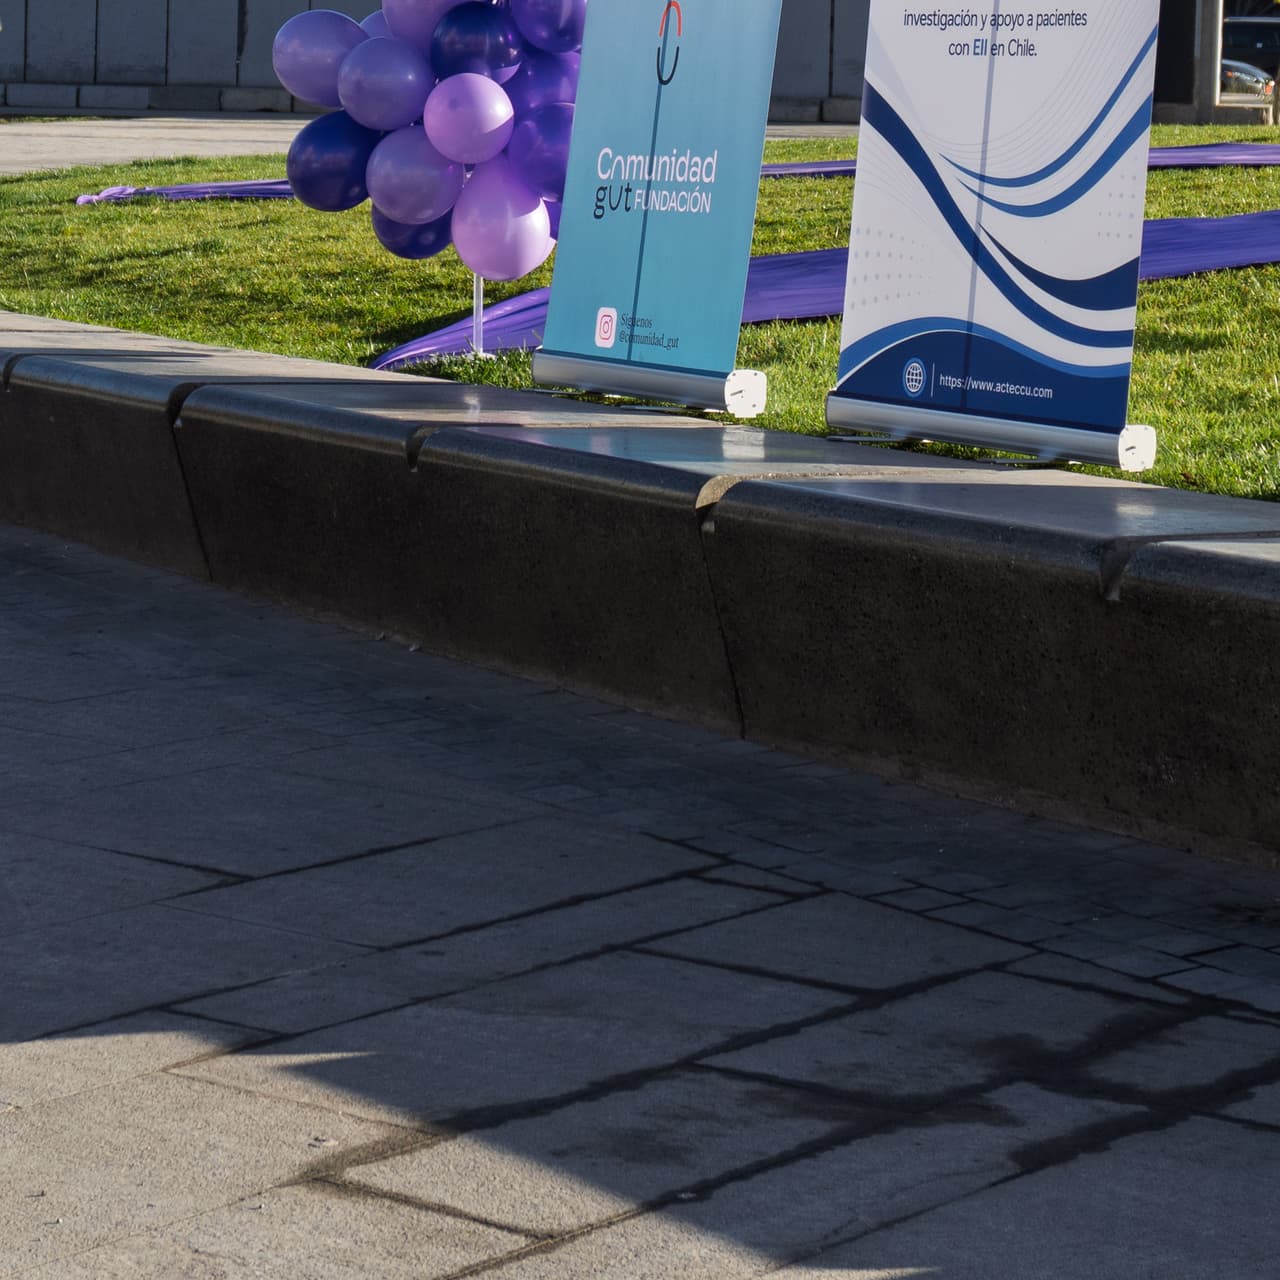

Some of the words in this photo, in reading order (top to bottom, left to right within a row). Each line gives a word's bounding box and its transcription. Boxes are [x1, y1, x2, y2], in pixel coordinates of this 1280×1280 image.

[903, 9, 978, 31] investigación
[980, 14, 988, 31] y
[990, 14, 1024, 31] apoyo
[1026, 14, 1034, 27] a
[1036, 9, 1088, 31] pacientes
[948, 42, 970, 57] con
[990, 42, 1005, 57] en
[1008, 38, 1038, 57] Chile.
[593, 182, 632, 220] gut
[634, 186, 712, 214] FUNDACIÓN
[619, 330, 679, 351] @comunidad_gut
[939, 374, 1053, 399] https://www.acteccu.com
